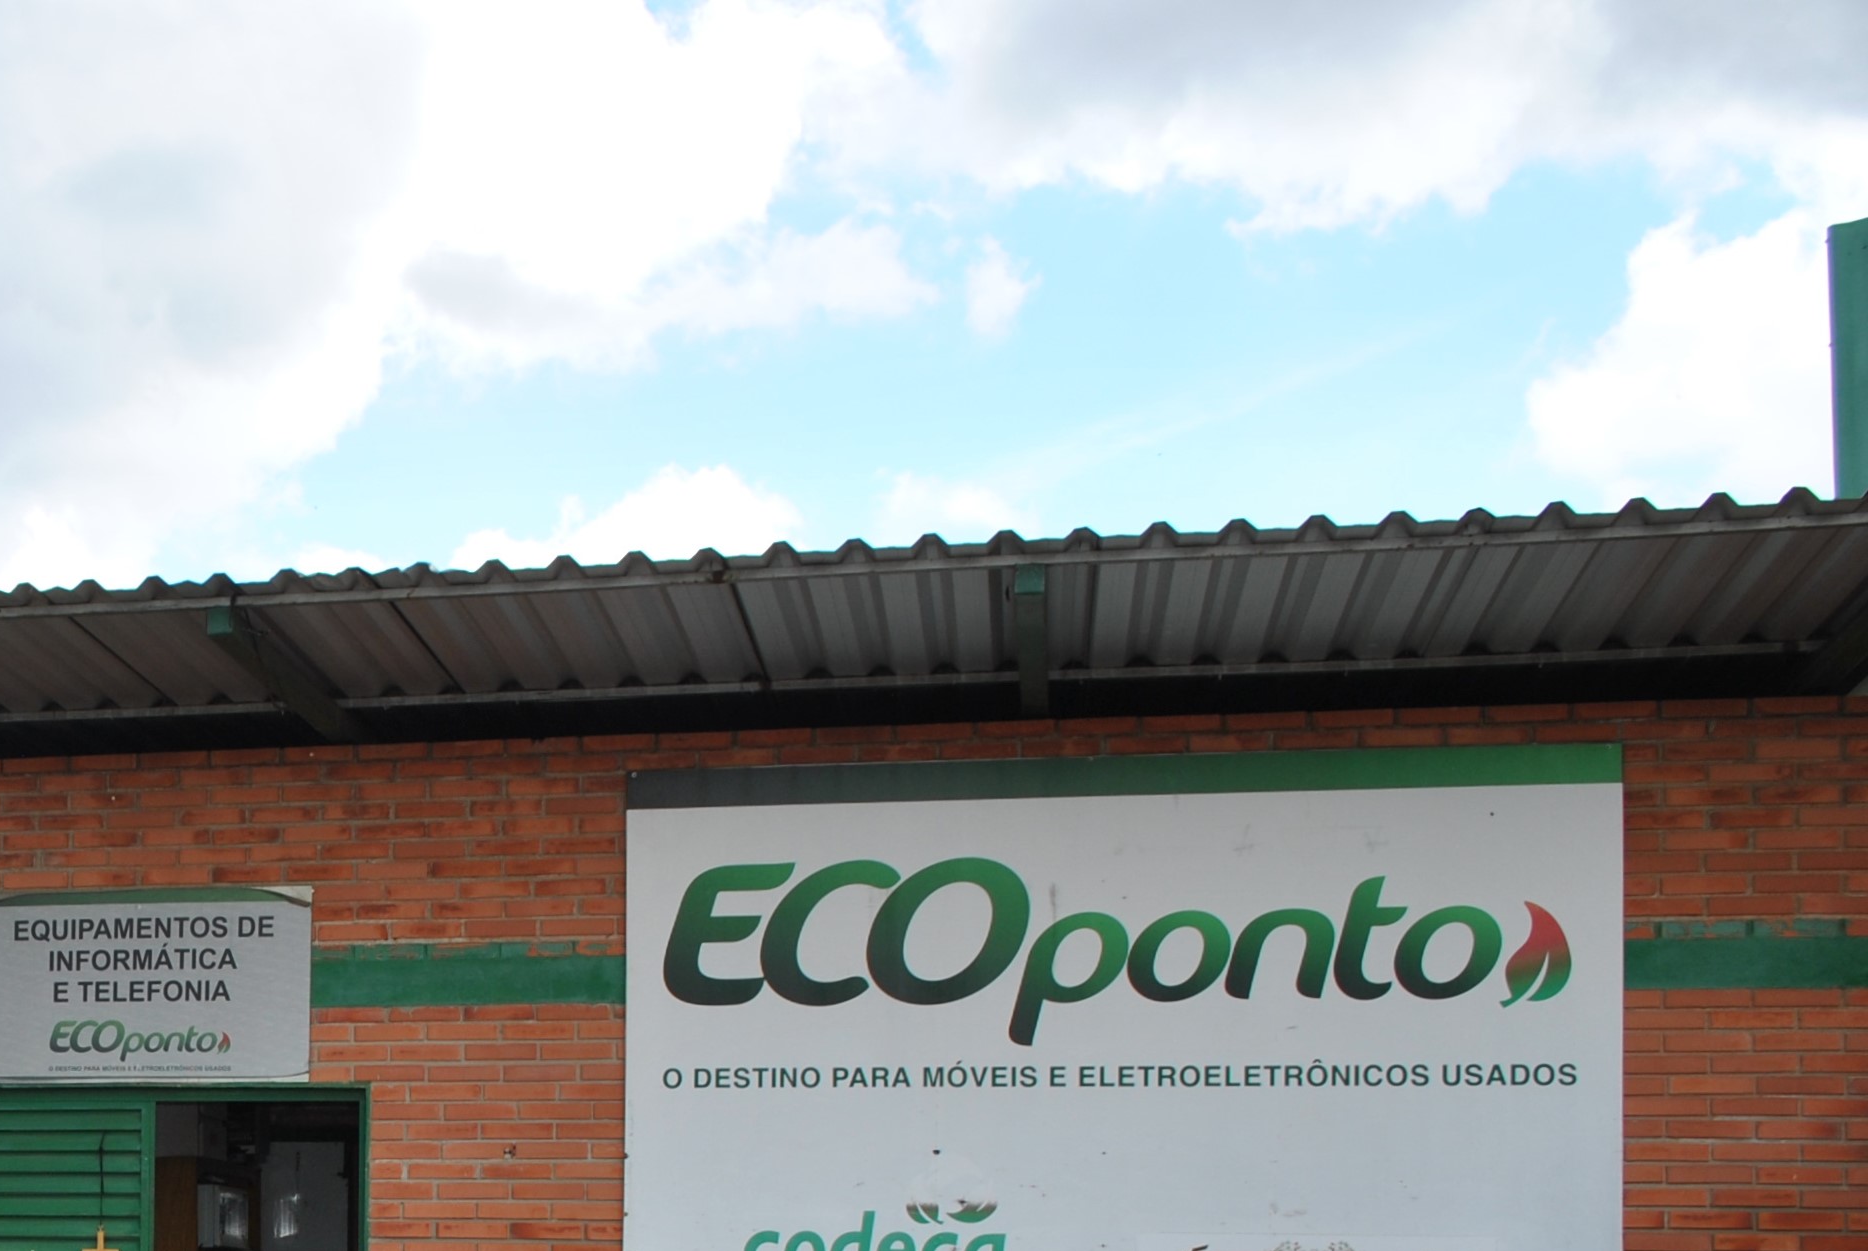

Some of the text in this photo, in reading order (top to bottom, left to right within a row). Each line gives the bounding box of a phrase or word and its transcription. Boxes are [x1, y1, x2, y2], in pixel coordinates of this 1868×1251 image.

[13, 916, 275, 941] EQUIPAMENTOS DE
[48, 943, 237, 971] INFORMÁTICA
[663, 857, 1503, 1046] ECOponto
[53, 980, 231, 1002] E TELEFONIA
[49, 1020, 218, 1062] ECOponto
[662, 1059, 1577, 1089] O DESTINO PARA MÓVEIS E ELETROELETRÔNICOS USADOS
